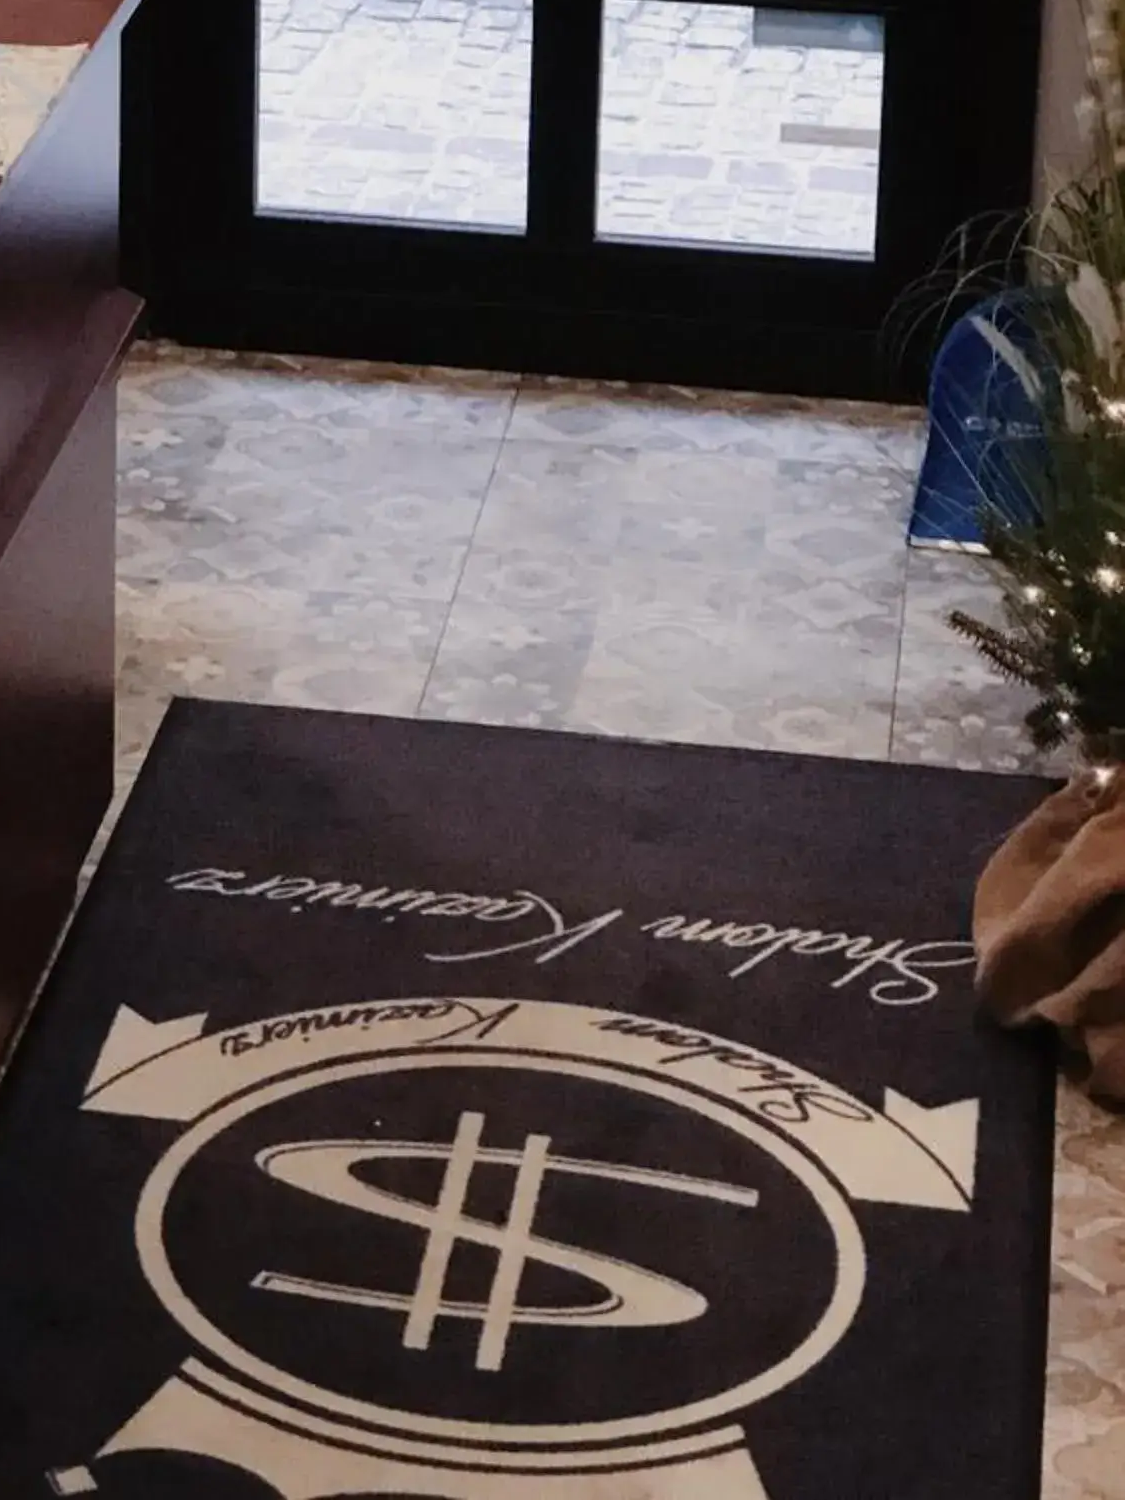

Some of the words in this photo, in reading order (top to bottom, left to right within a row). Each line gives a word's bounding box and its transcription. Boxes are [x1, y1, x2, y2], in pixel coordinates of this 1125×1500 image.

[167, 867, 623, 964] Kazimierz
[641, 915, 977, 1005] Shalom
[589, 1018, 874, 1123] Shalom
